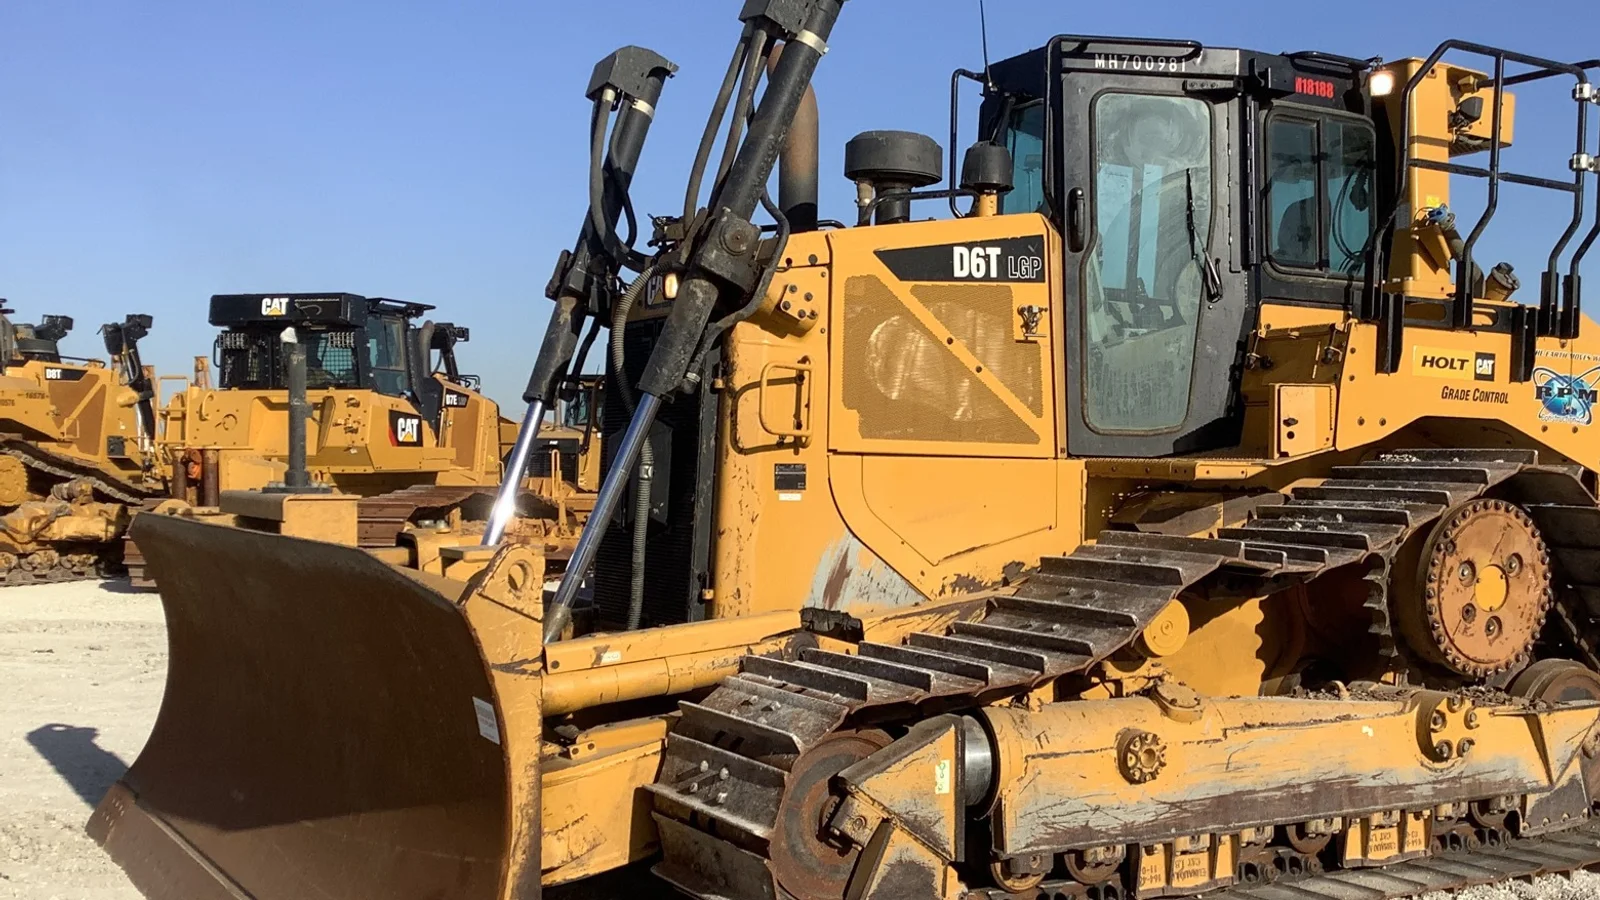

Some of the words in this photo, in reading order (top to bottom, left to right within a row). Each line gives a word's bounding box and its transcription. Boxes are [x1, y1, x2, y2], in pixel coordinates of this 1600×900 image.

[1094, 53, 1186, 72] MH700981
[953, 246, 1001, 278] D6T
[1007, 256, 1042, 279] LGP
[647, 275, 664, 305] CA
[261, 298, 289, 316] CAT
[45, 368, 61, 379] D8T
[1421, 355, 1469, 371] HOLT
[1475, 358, 1494, 375] CAT
[445, 394, 457, 405] D7E
[1535, 385, 1598, 403] RPM
[397, 417, 419, 442] CAT
